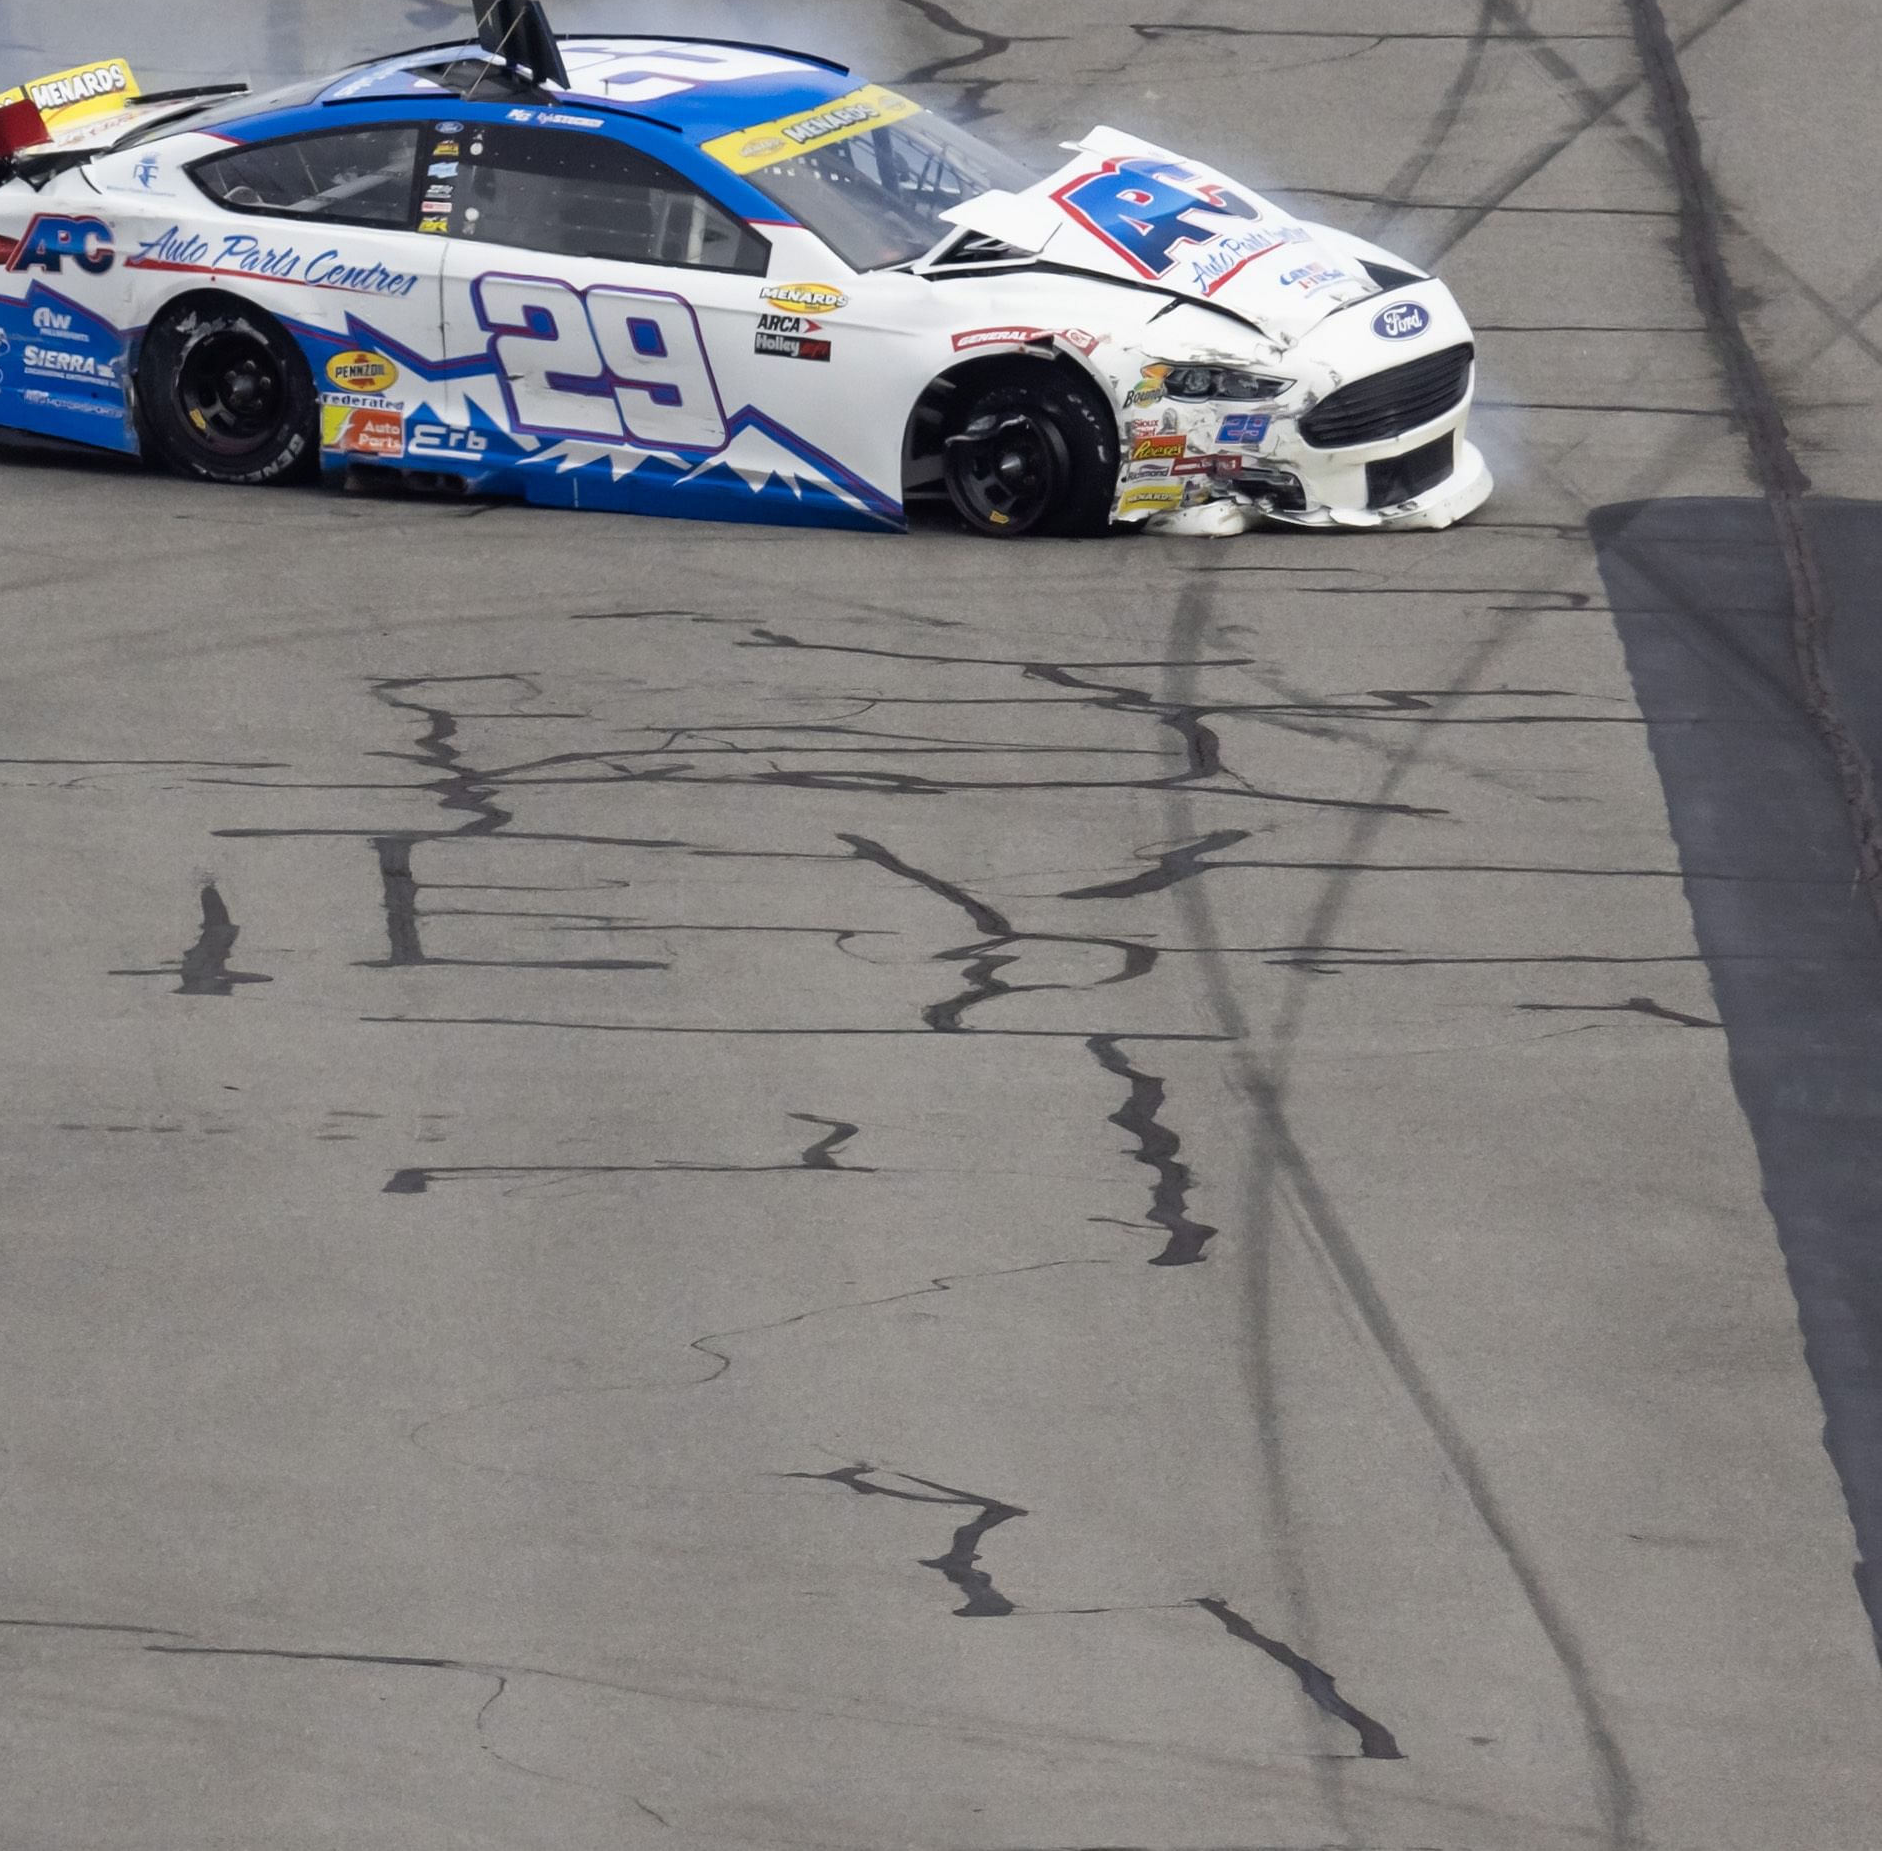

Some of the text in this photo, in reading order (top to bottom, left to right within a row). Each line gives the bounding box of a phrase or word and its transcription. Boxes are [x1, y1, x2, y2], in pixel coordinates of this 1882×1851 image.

[31, 64, 126, 112] MENARDS
[784, 105, 877, 143] MENARDS
[6, 212, 115, 276] APC
[137, 225, 417, 296] Auto Parts Centres
[1192, 249, 1234, 293] Auto
[759, 287, 849, 308] MENARDS
[757, 313, 801, 332] ARCA
[1384, 306, 1422, 336] Ford
[756, 333, 800, 357] Holley
[957, 331, 1027, 346] GENERAL
[23, 345, 96, 375] SIERRA
[335, 364, 386, 379] PENNZOIL
[471, 271, 733, 453] 29
[322, 394, 404, 410] Federated
[363, 420, 401, 435] Auto
[1132, 419, 1159, 429] Sioux
[358, 433, 403, 448] Parts
[408, 423, 487, 454] Erb
